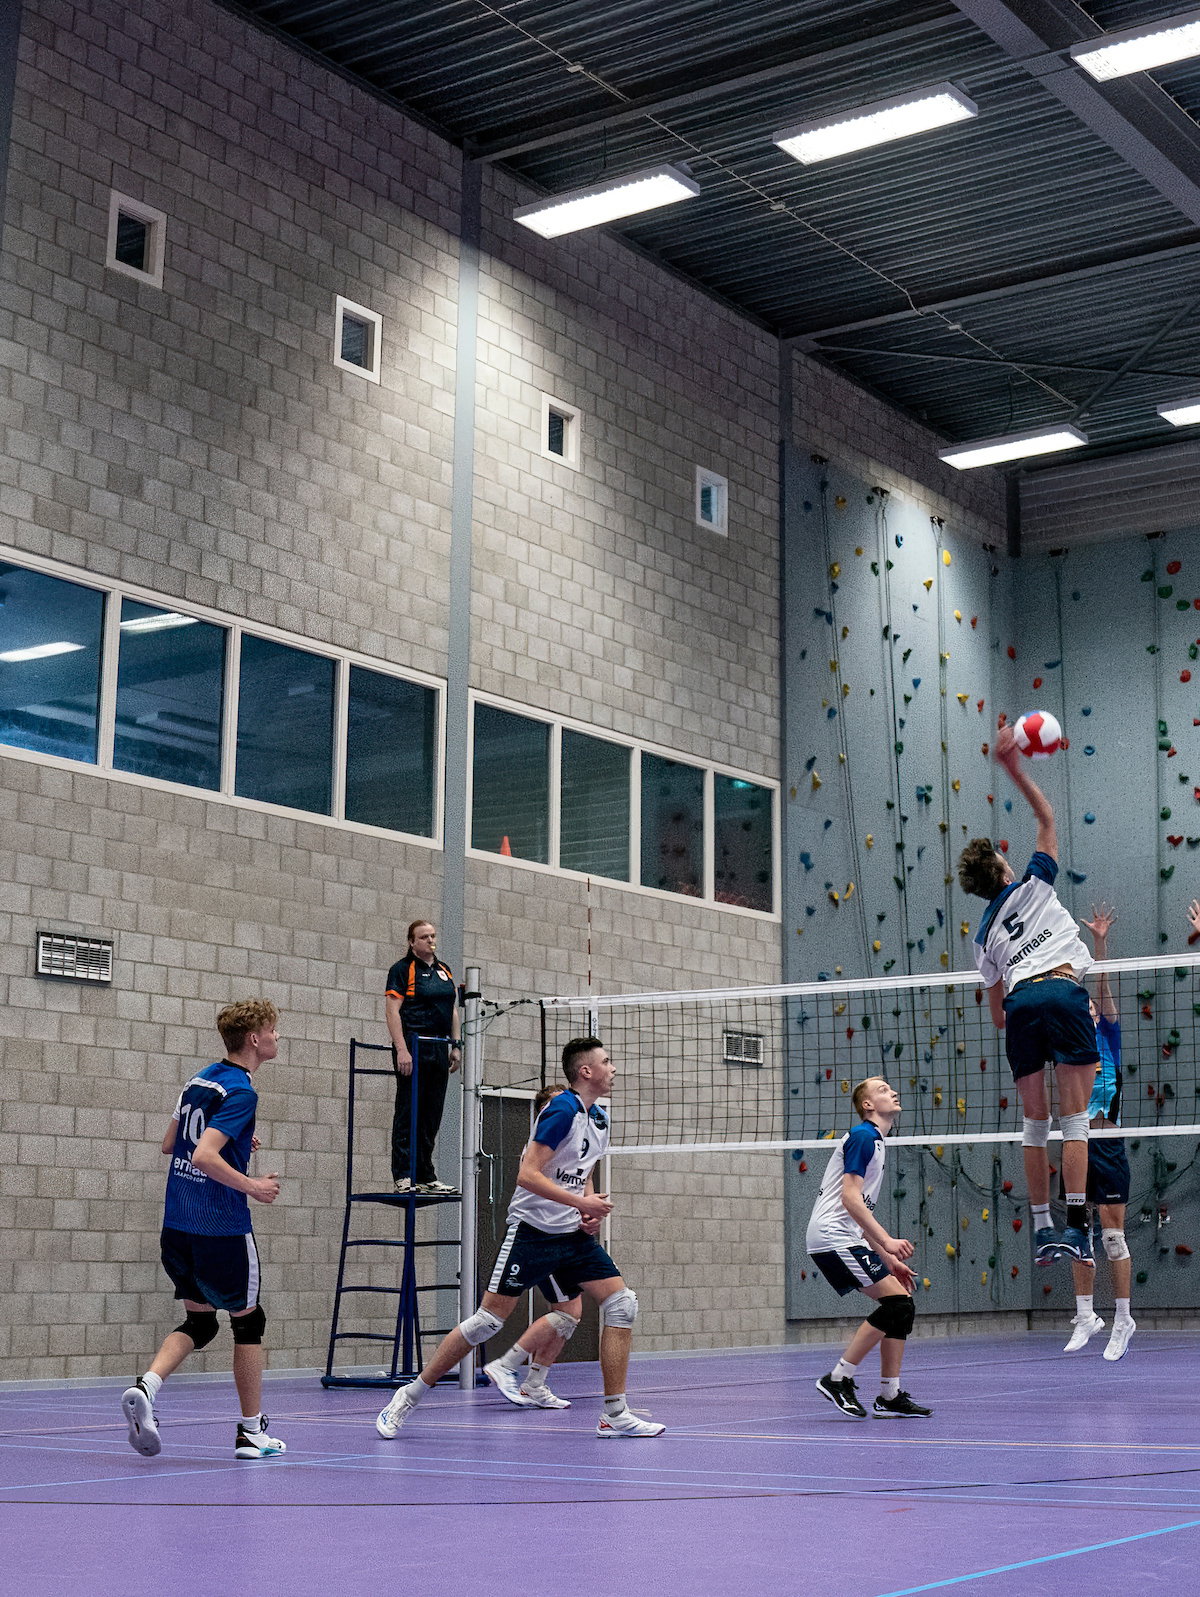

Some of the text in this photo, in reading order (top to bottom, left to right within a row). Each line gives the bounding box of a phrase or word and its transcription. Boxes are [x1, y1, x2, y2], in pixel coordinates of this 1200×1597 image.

[1002, 911, 1025, 942] 5
[181, 1103, 206, 1146] 10
[581, 1138, 590, 1159] 9
[509, 1263, 520, 1276] 9
[861, 1254, 871, 1266] 7
